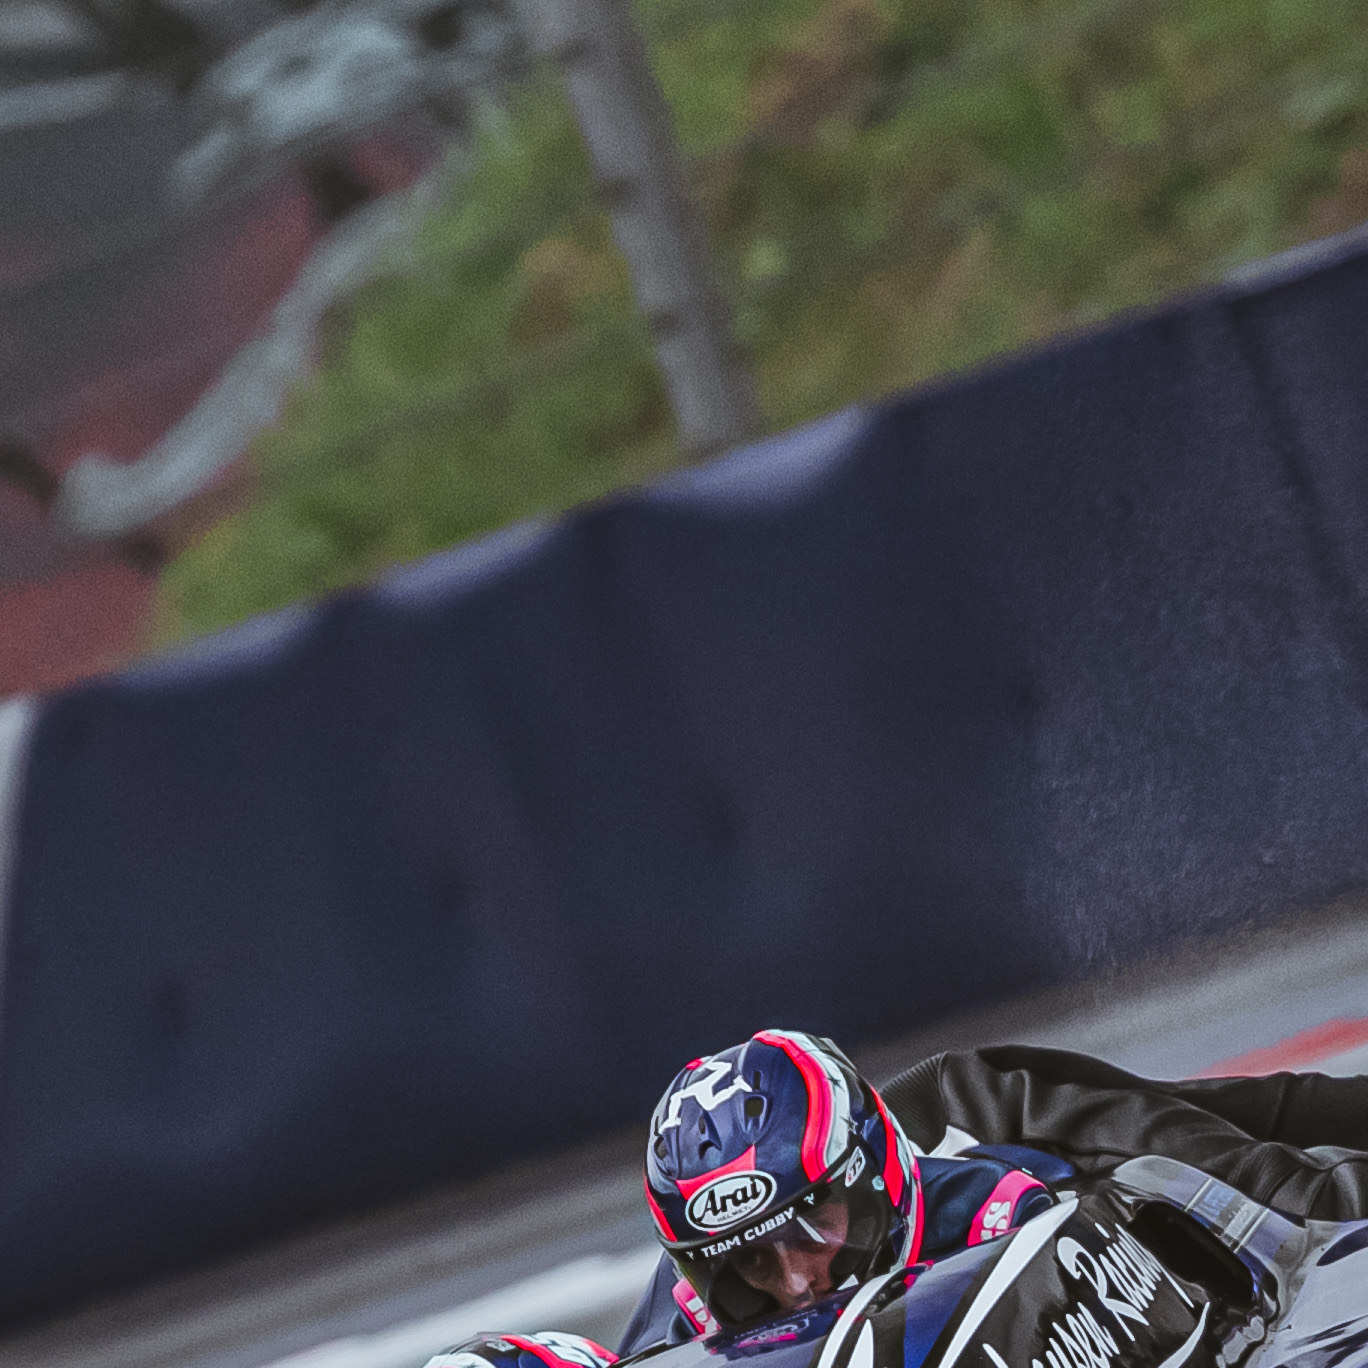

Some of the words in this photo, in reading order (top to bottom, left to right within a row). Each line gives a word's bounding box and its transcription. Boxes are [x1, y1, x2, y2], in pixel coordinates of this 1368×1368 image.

[696, 1176, 760, 1223] Arai
[700, 1236, 741, 1257] TEAM
[744, 1206, 794, 1240] CUBBY
